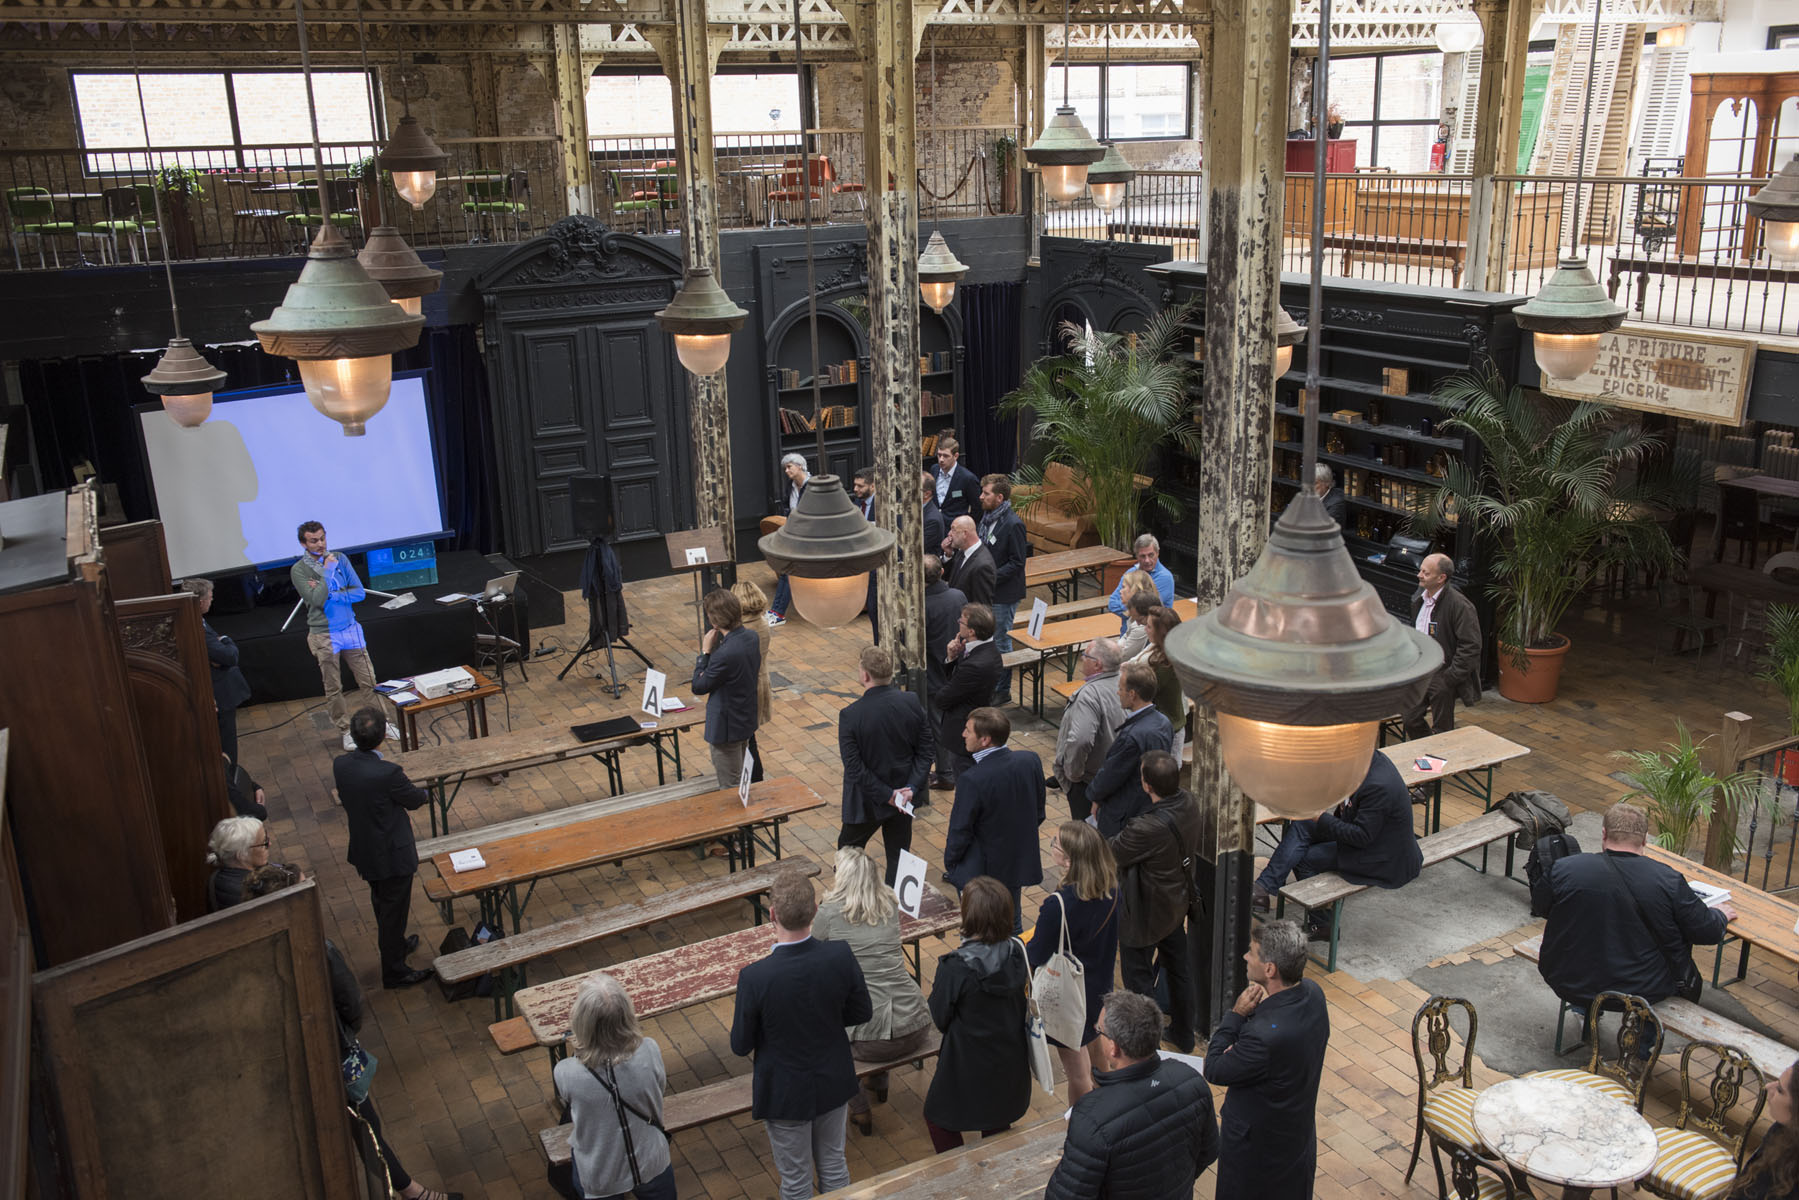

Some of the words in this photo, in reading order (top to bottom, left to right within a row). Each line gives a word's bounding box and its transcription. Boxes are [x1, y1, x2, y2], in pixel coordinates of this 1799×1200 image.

[1626, 337, 1706, 364] FRITURE
[1608, 355, 1730, 393] RESTAURANT
[1602, 378, 1670, 402] EPICERIE
[644, 685, 659, 714] A
[741, 767, 749, 800] B
[899, 875, 919, 913] C
